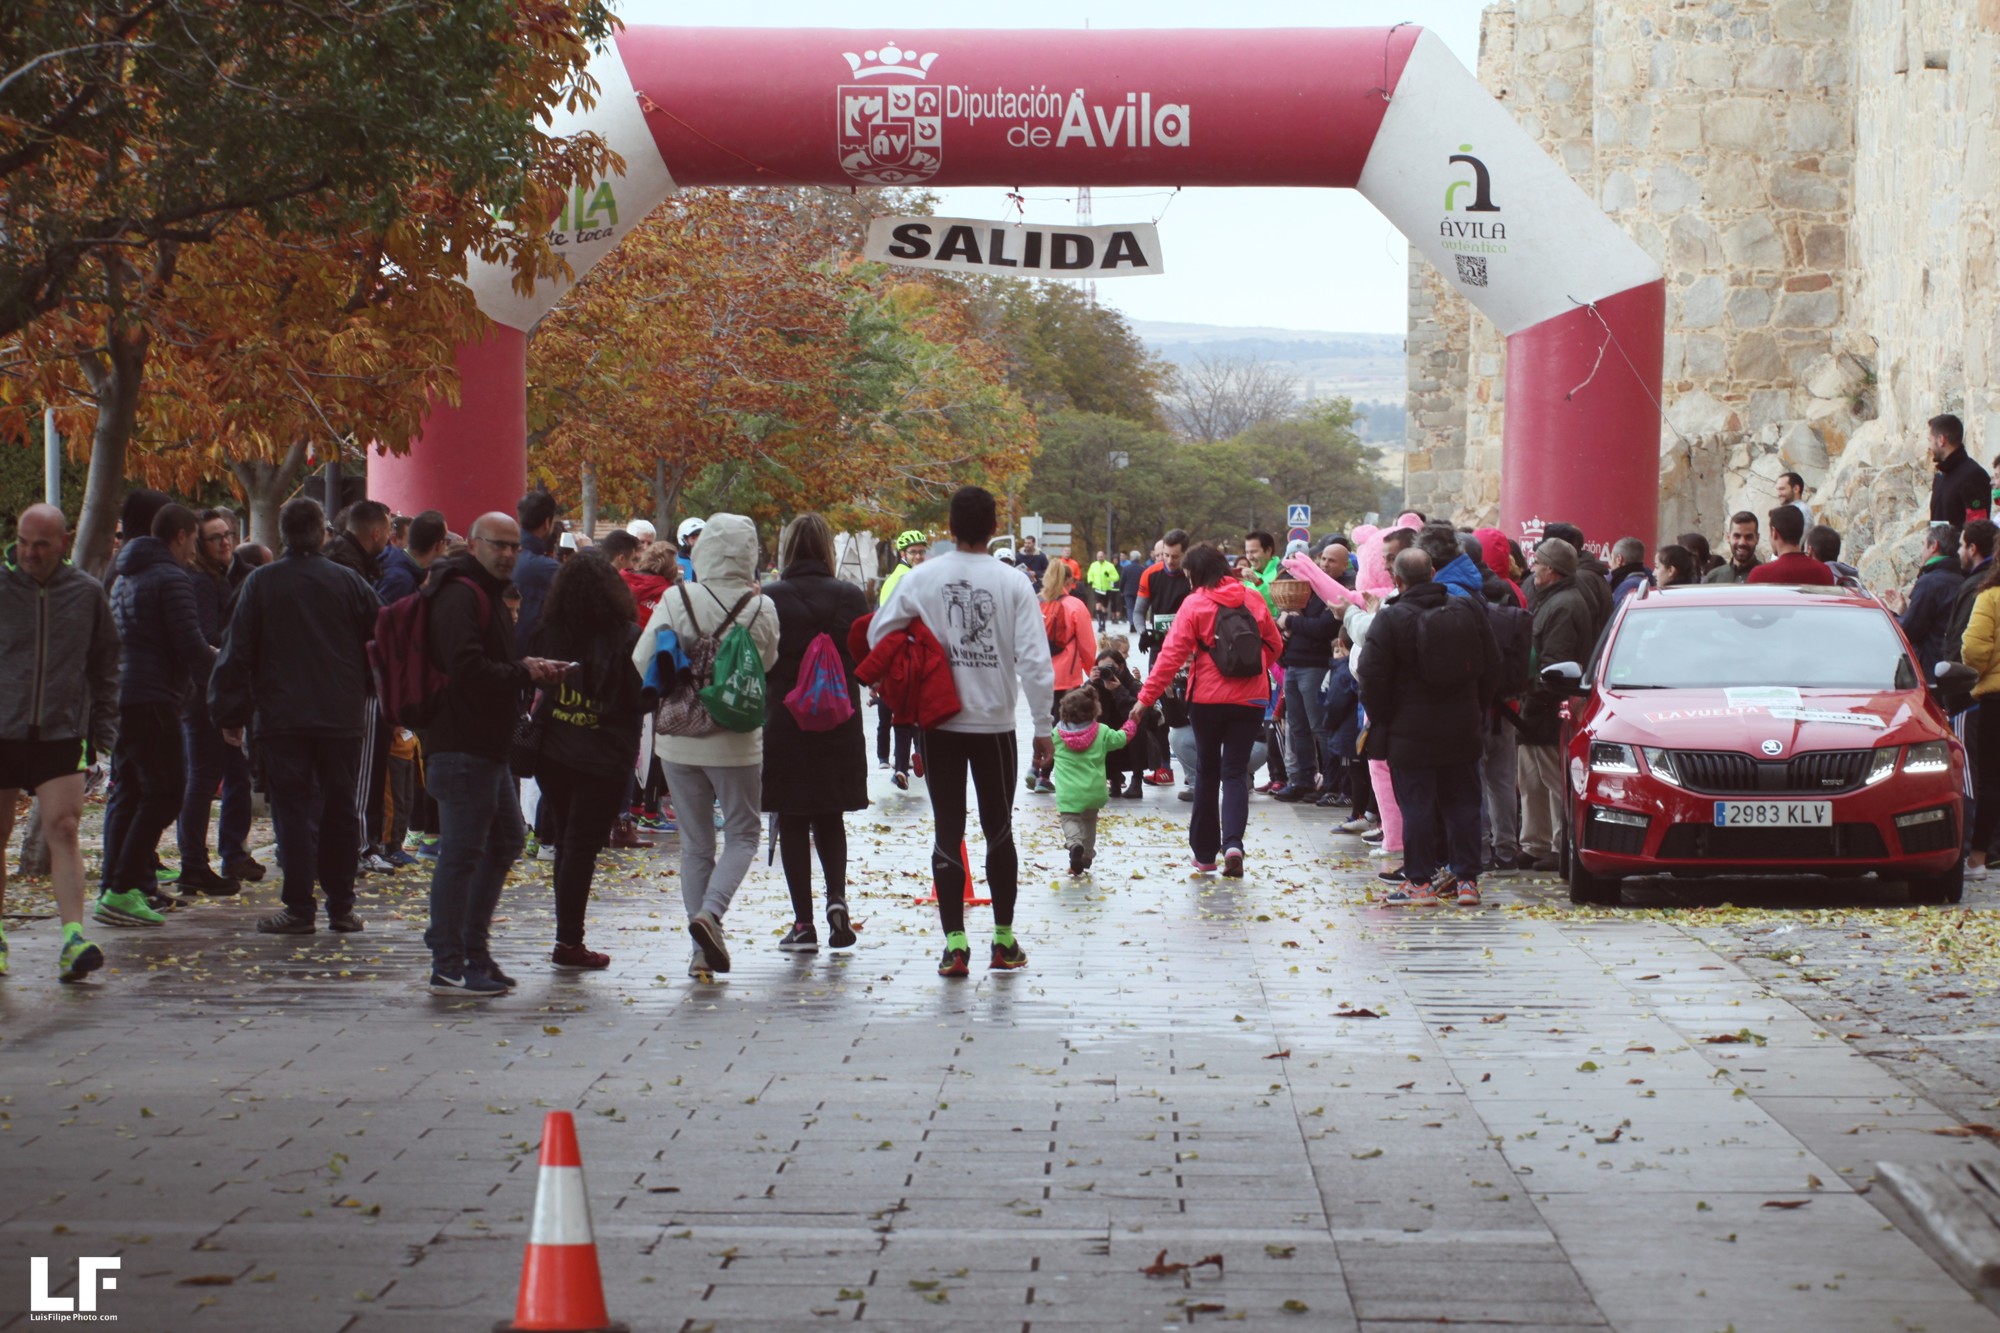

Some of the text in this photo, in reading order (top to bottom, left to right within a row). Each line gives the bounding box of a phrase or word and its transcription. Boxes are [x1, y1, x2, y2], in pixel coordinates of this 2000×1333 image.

[946, 85, 1062, 126] Diputación
[1007, 88, 1190, 148] de Ávila
[575, 227, 613, 243] toca
[1440, 216, 1507, 240] ÁVILA
[888, 222, 1149, 269] SALIDA
[1441, 241, 1507, 253] auténtica
[1659, 711, 1682, 720] LA
[1684, 706, 1759, 718] VUELTA
[1730, 805, 1825, 824] 2983 KLV
